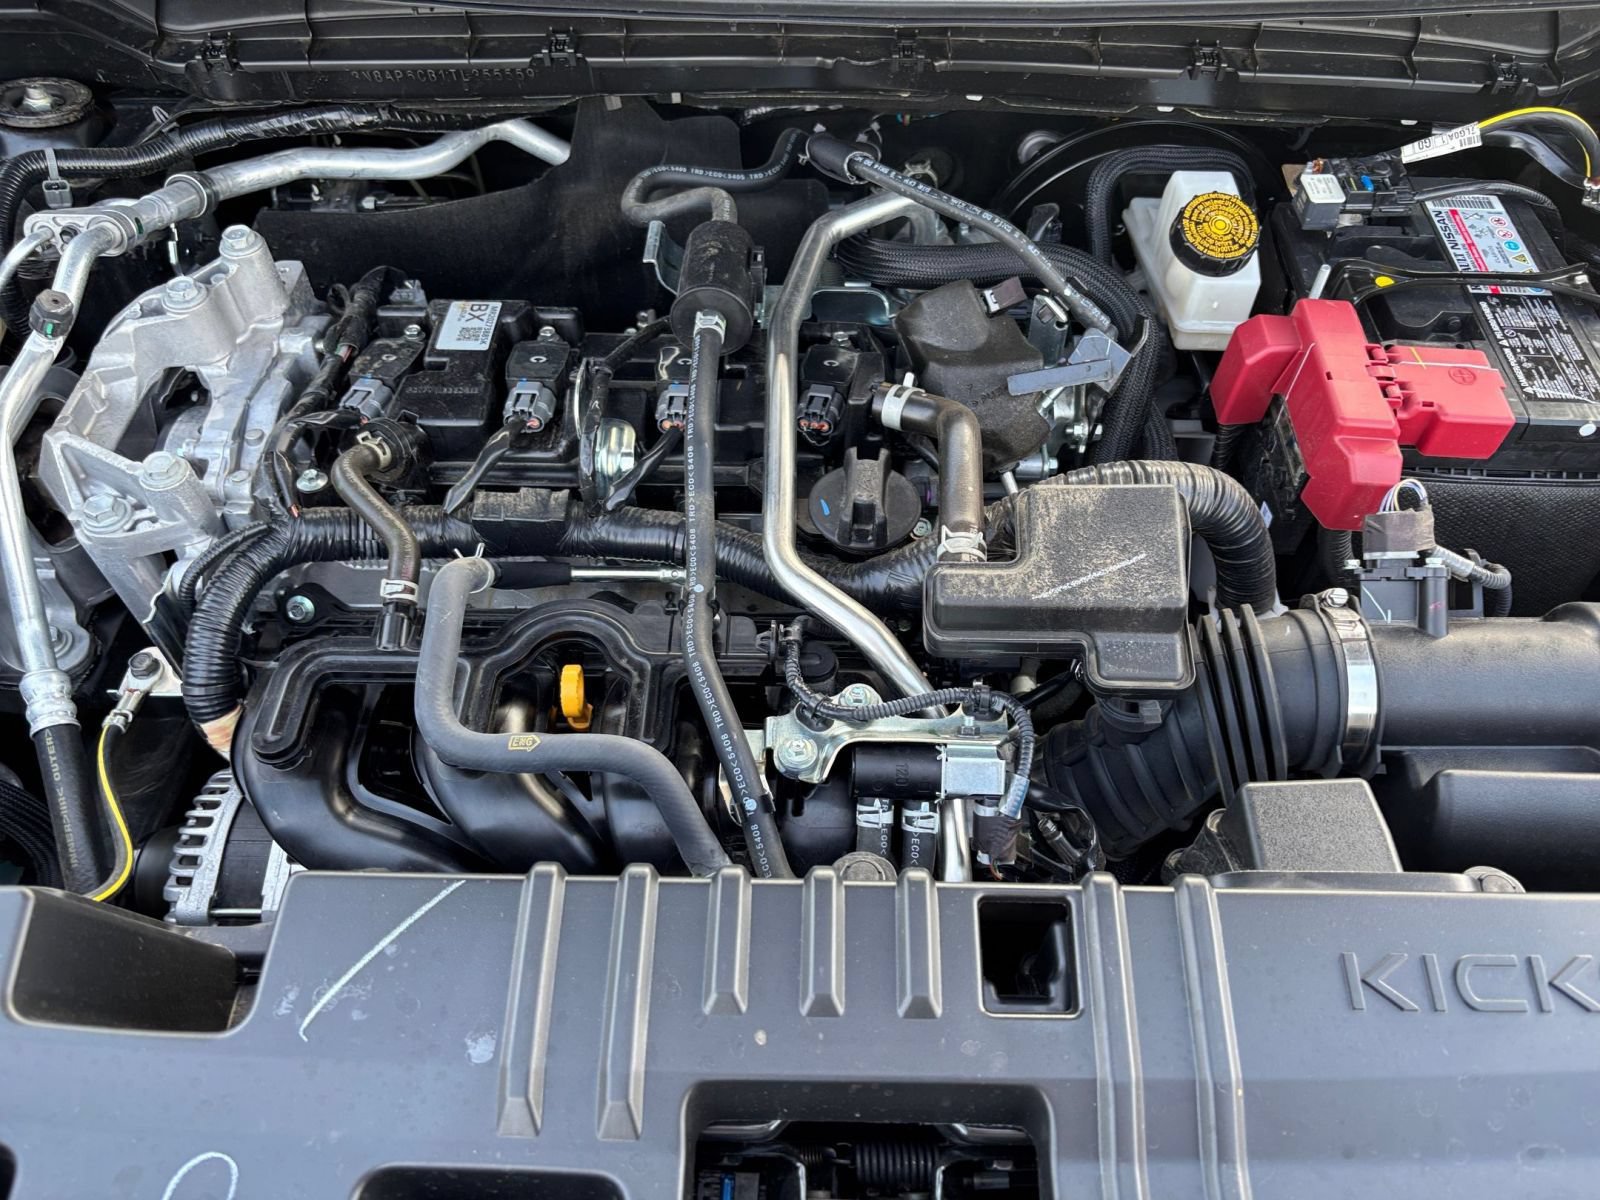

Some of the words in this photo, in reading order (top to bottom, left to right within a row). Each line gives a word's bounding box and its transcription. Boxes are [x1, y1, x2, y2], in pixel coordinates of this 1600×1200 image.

[1432, 210, 1461, 249] NISSAN
[465, 304, 489, 322] BX
[512, 736, 533, 746] ENG
[1339, 951, 1600, 1013] KICK
